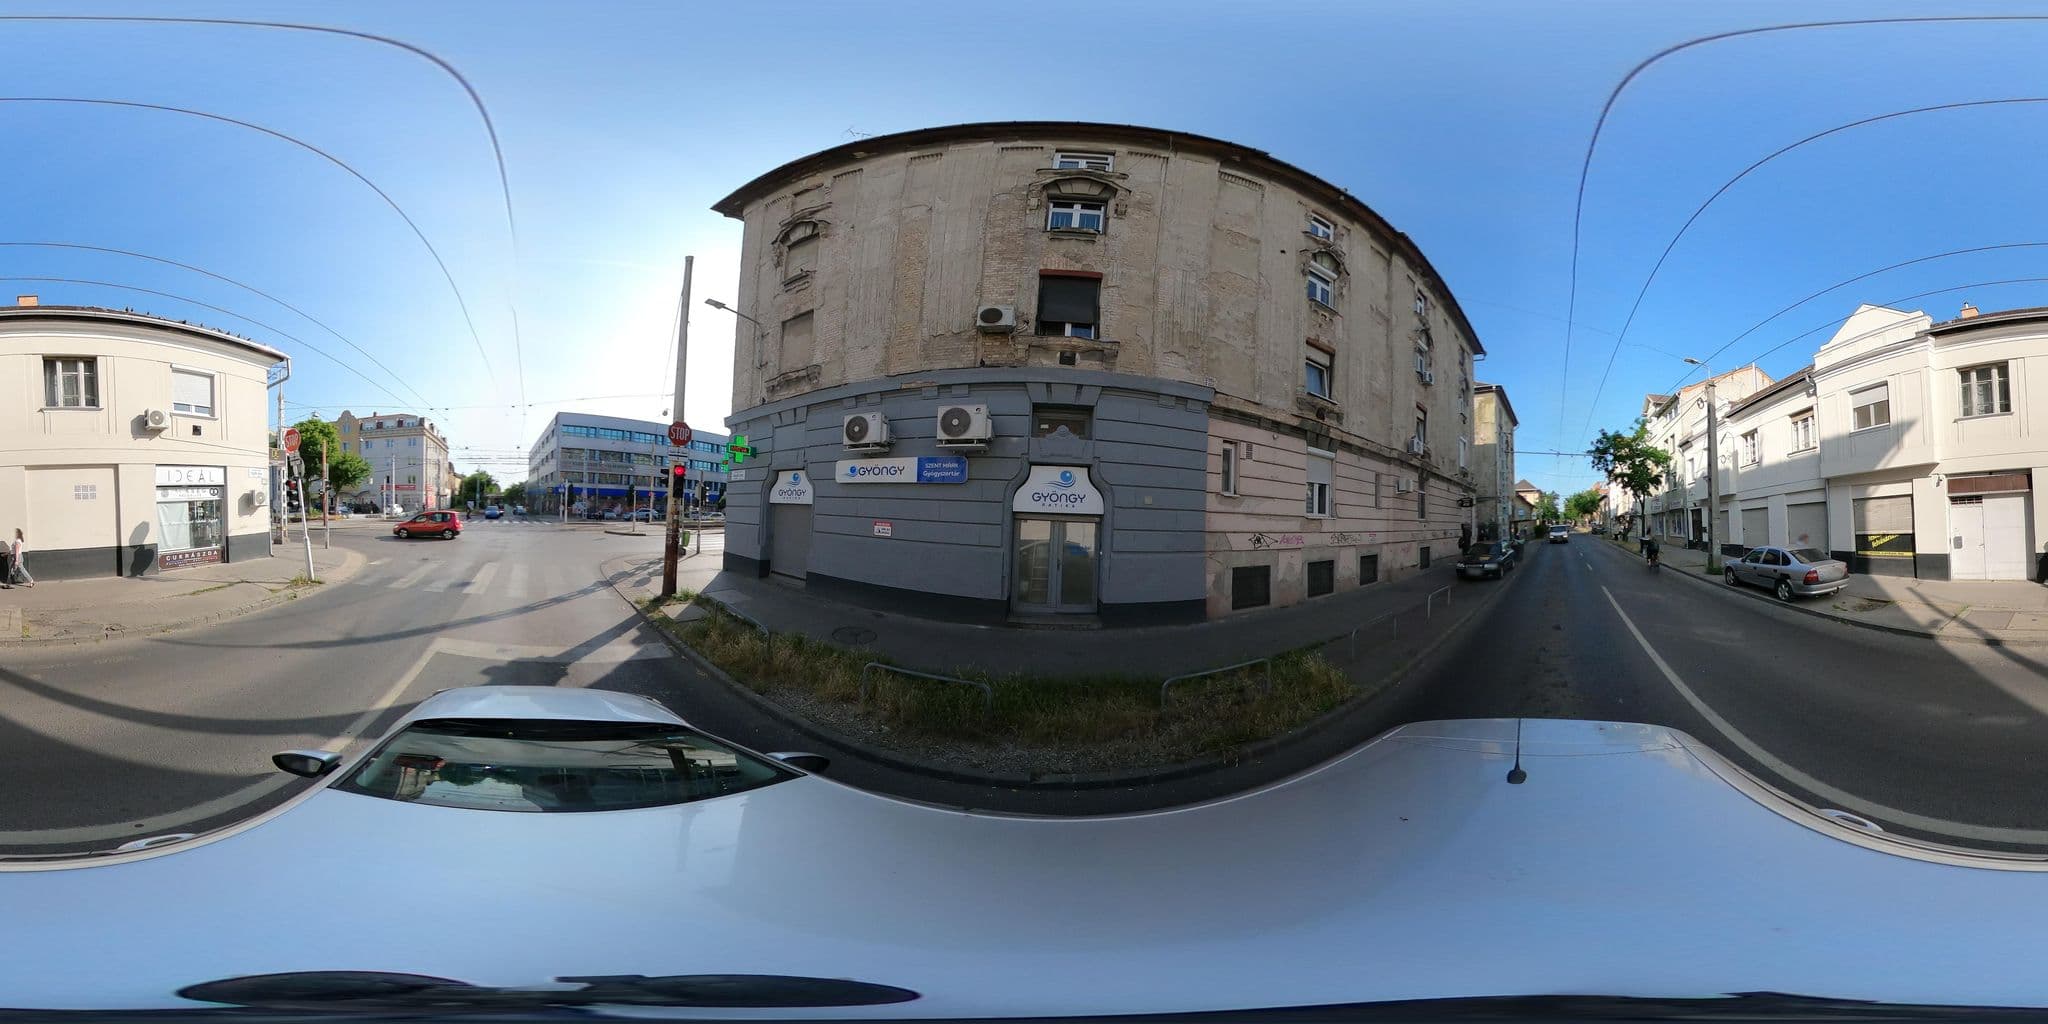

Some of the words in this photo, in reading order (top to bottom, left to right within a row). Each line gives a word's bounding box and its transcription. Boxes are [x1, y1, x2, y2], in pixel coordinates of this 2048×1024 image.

[286, 433, 298, 447] STOP
[671, 427, 690, 440] STOP
[858, 463, 905, 477] GYÖNGY
[778, 488, 807, 498] GYÖNGY
[1032, 490, 1086, 503] GYÖNGY
